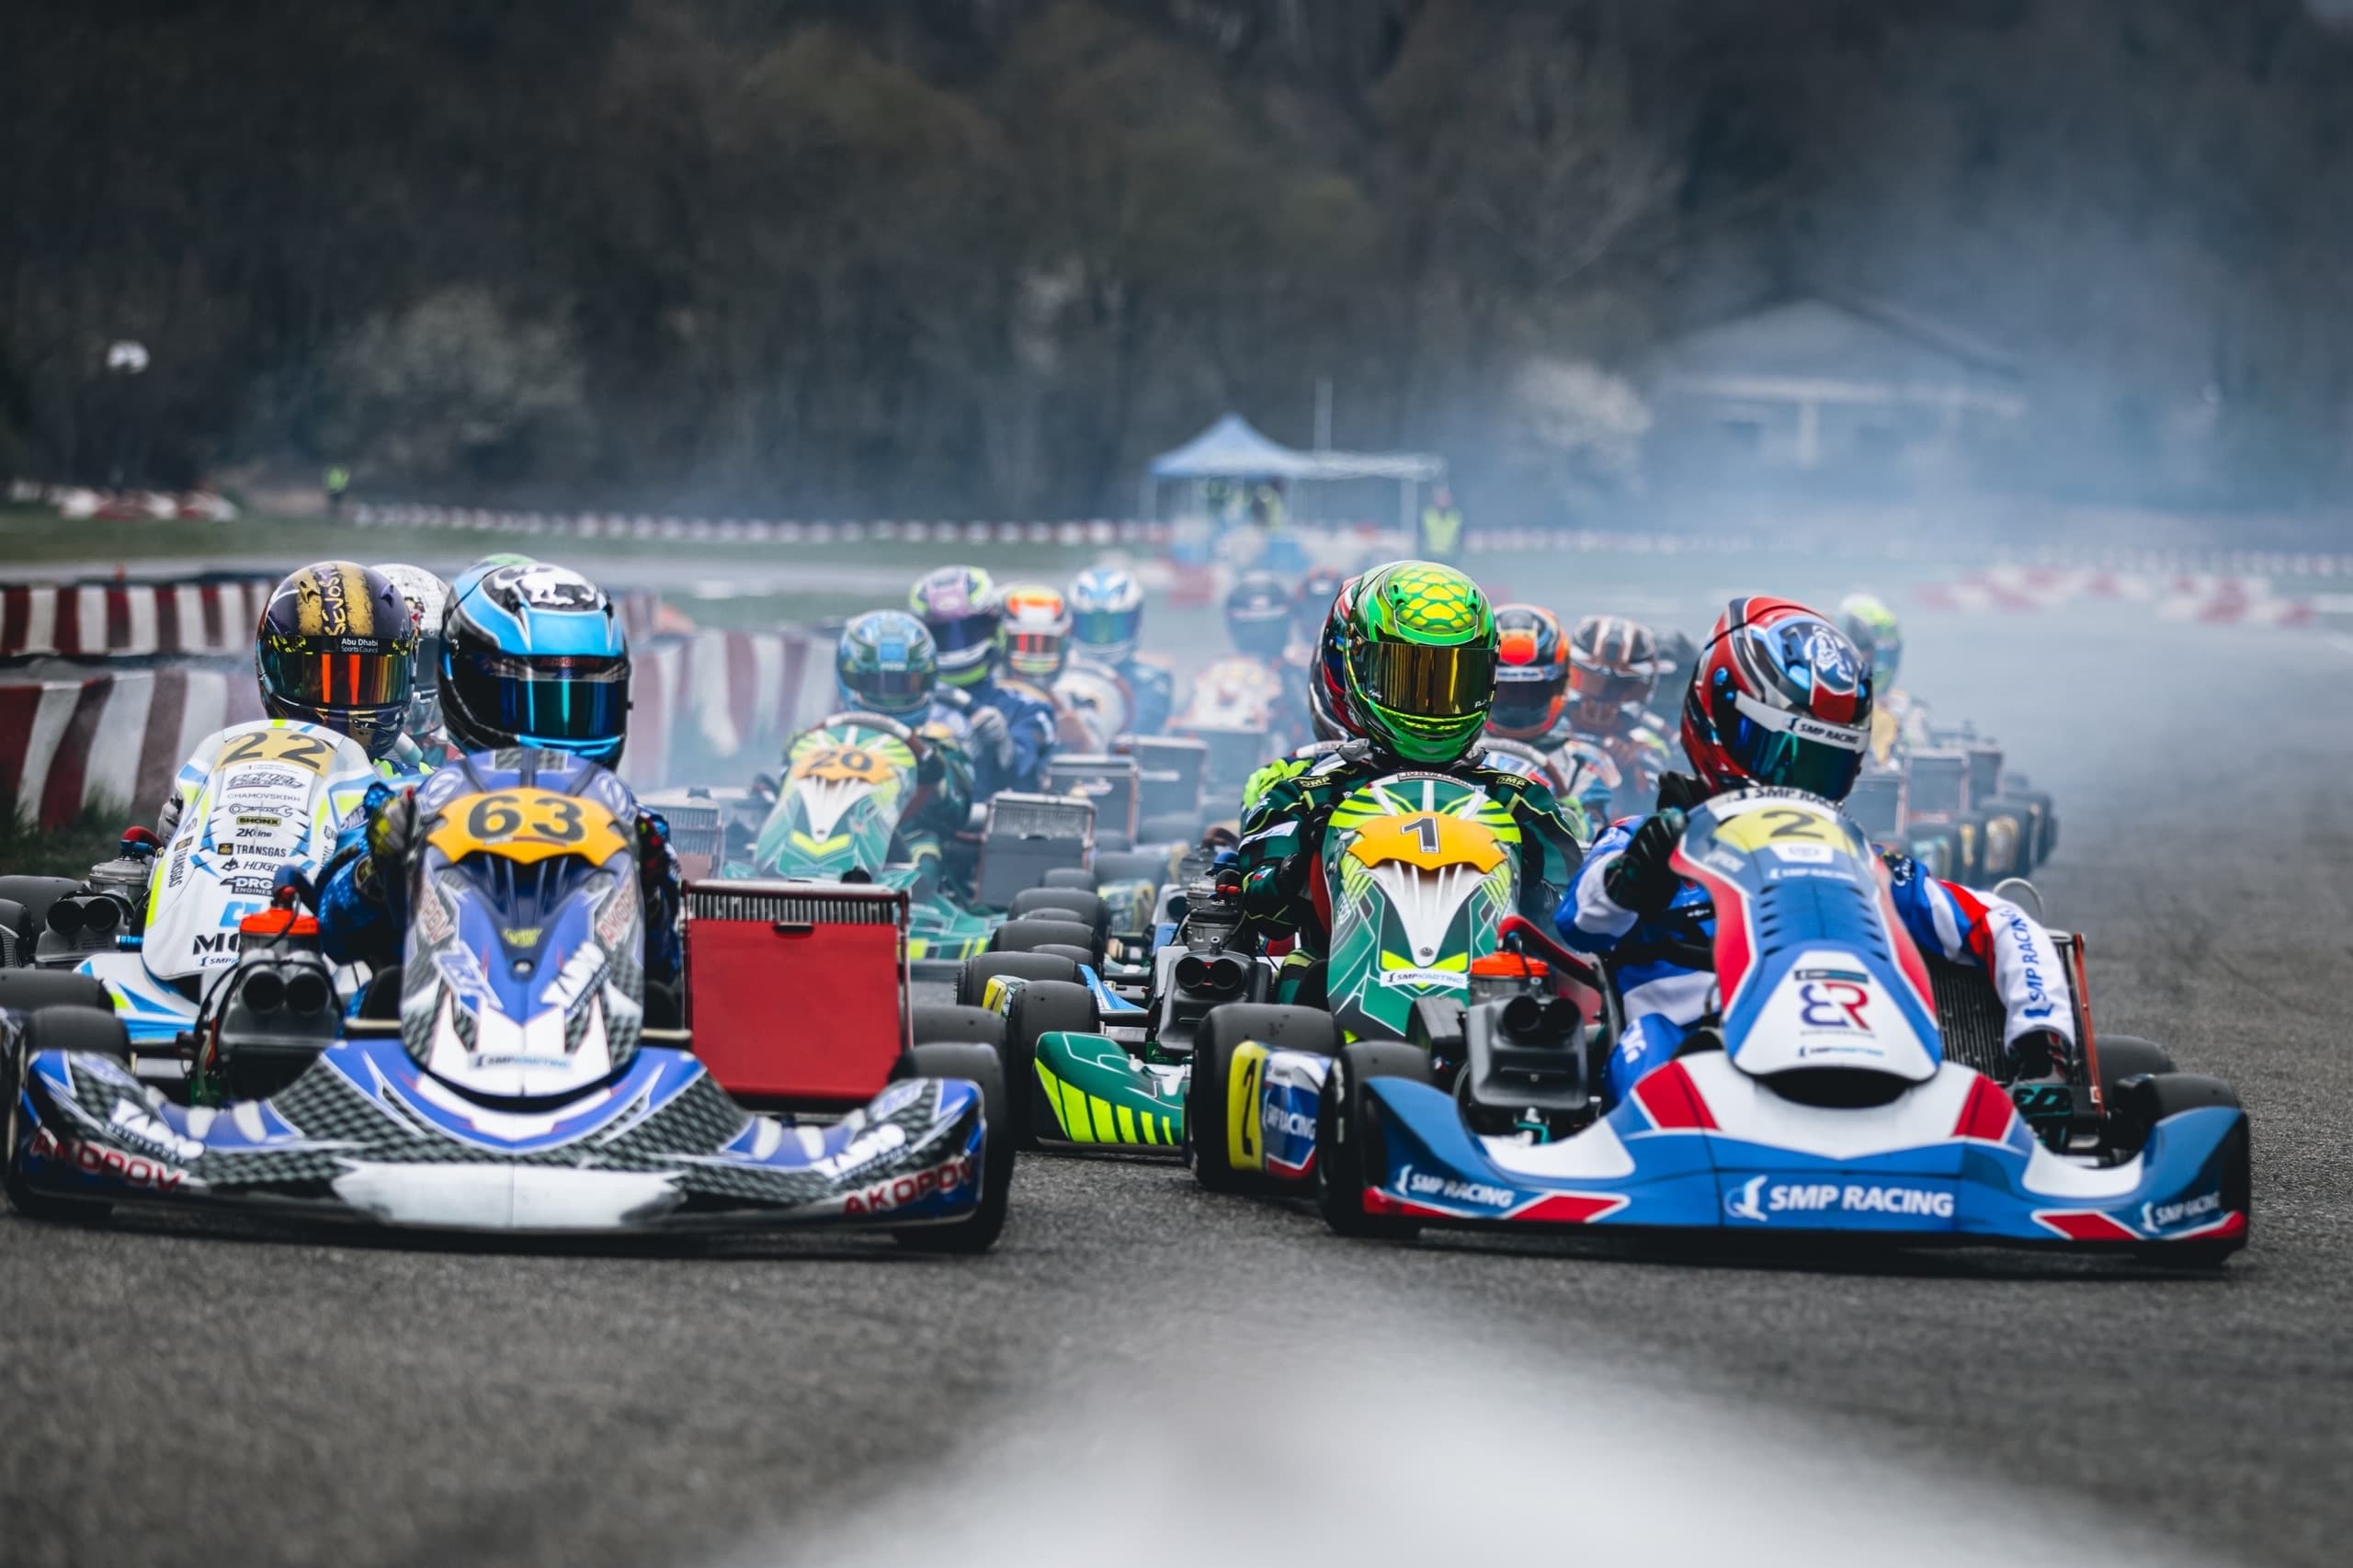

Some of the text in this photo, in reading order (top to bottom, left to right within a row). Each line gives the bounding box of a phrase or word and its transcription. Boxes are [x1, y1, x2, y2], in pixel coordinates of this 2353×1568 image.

[1800, 723, 1859, 744] SMP RACING
[221, 733, 326, 769] 22
[1300, 777, 1331, 788] OMP
[1496, 776, 1527, 789] OMP
[468, 795, 585, 841] 63
[1761, 810, 1826, 839] 2
[1401, 816, 1440, 853] 1
[236, 845, 287, 858] TRANSGAS
[234, 888, 273, 896] ENGINES
[235, 877, 274, 889] DRG
[1410, 1174, 1515, 1208] SMP RACING
[1768, 1184, 1954, 1218] SMP RACING
[2155, 1203, 2184, 1225] SMP
